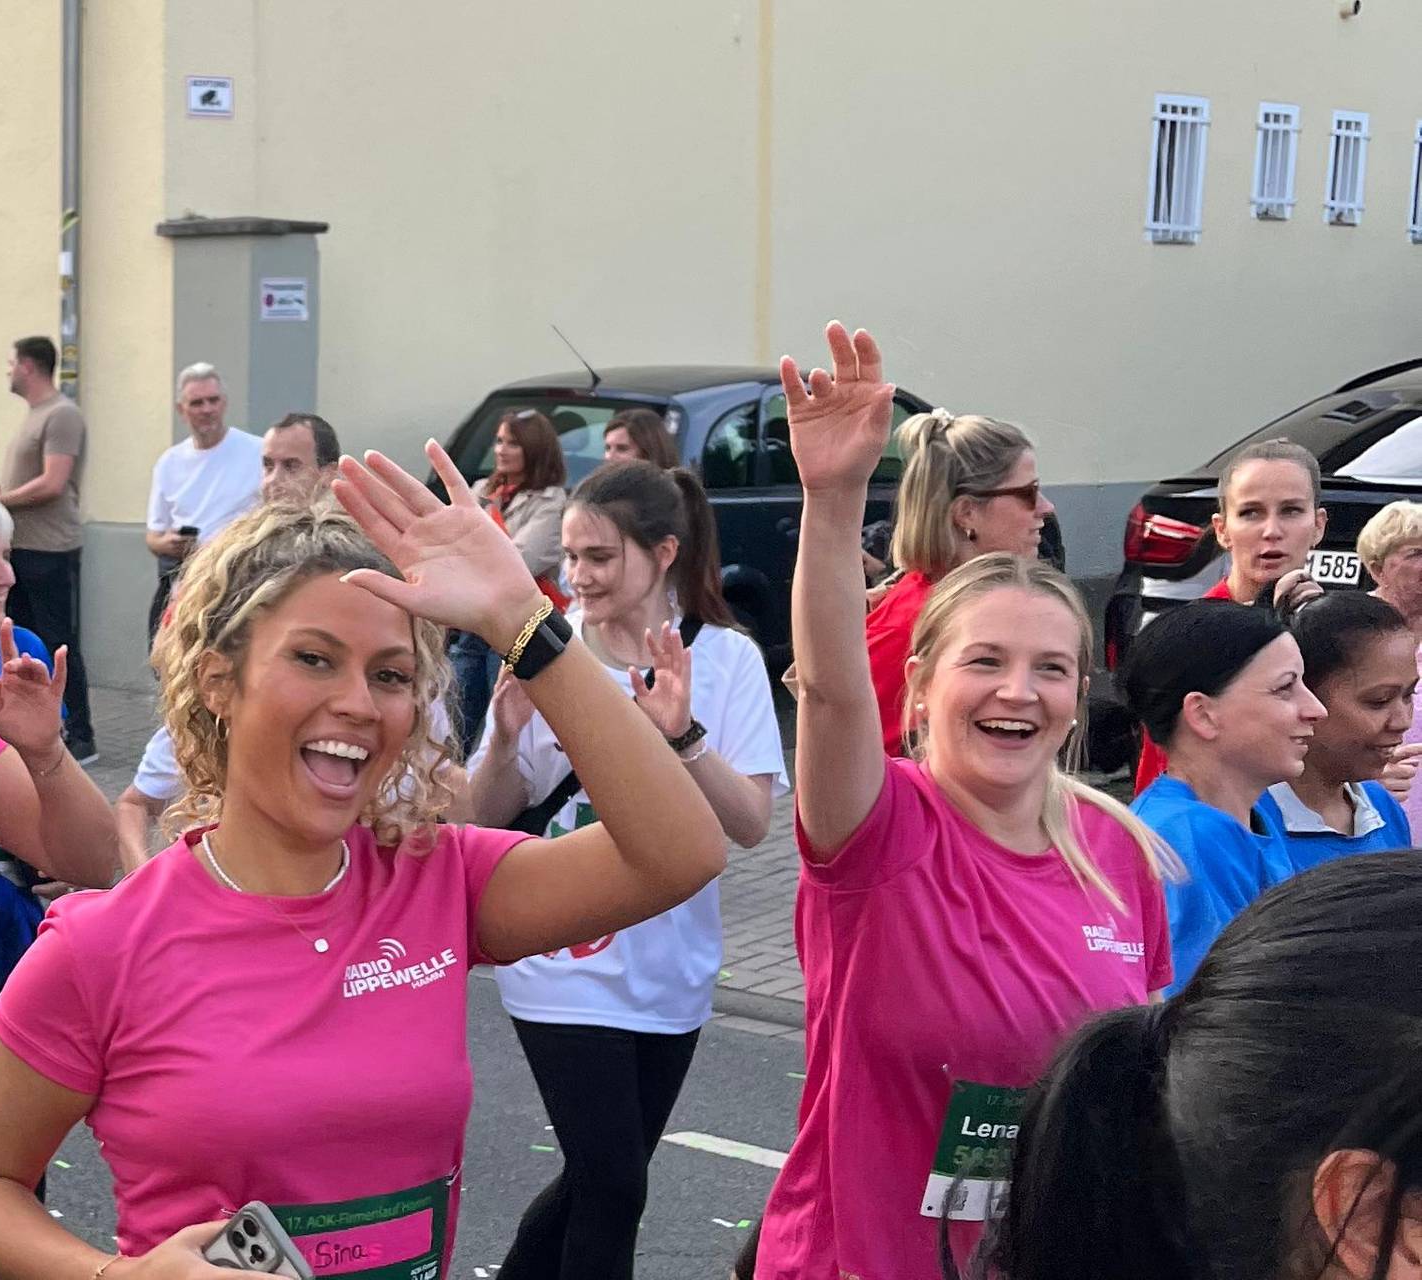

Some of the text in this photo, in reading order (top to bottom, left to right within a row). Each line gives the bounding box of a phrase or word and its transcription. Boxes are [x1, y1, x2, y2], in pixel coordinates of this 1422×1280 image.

[342, 948, 458, 998] LIPPEWELLE
[410, 969, 447, 990] HAMM
[961, 1115, 1020, 1139] Lena
[314, 1240, 369, 1269] Sina
